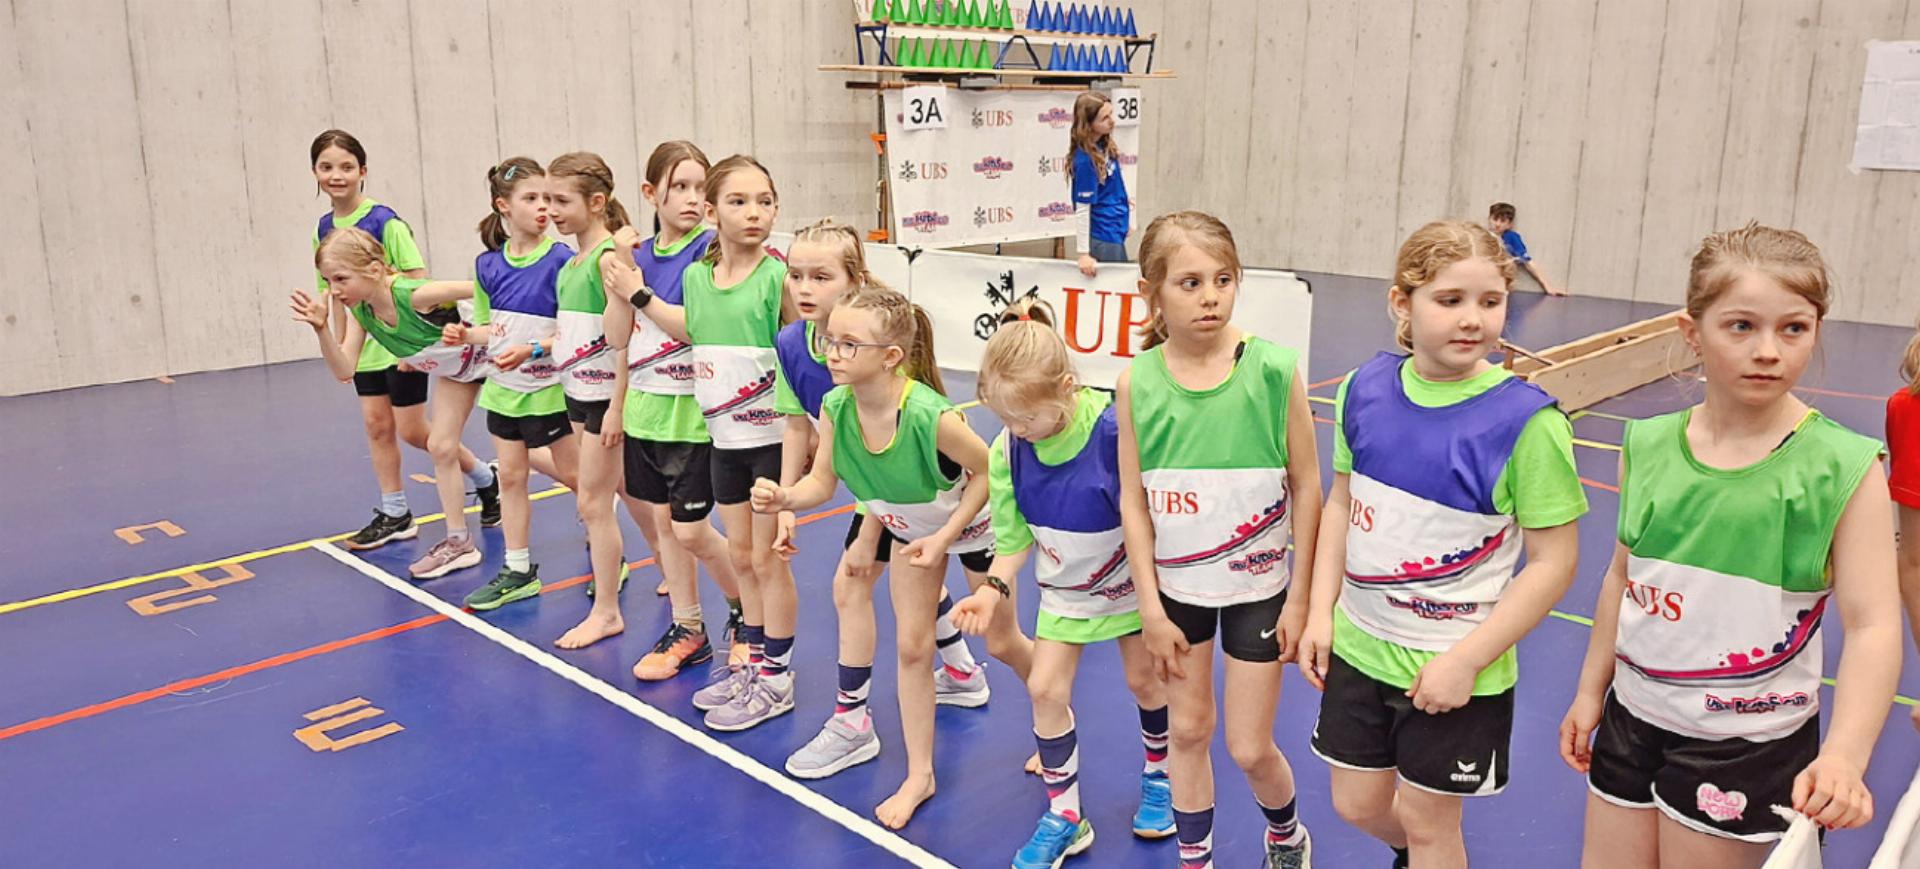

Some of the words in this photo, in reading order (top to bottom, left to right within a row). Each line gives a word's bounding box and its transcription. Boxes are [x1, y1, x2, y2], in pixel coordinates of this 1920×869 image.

[910, 97, 942, 124] 3A
[986, 110, 1013, 127] UBS
[1117, 98, 1138, 119] 3B
[921, 162, 948, 180] UBS
[987, 206, 1014, 224] UBS
[1062, 287, 1150, 358] UB
[1151, 490, 1199, 515] UBS
[1351, 498, 1375, 533] BS
